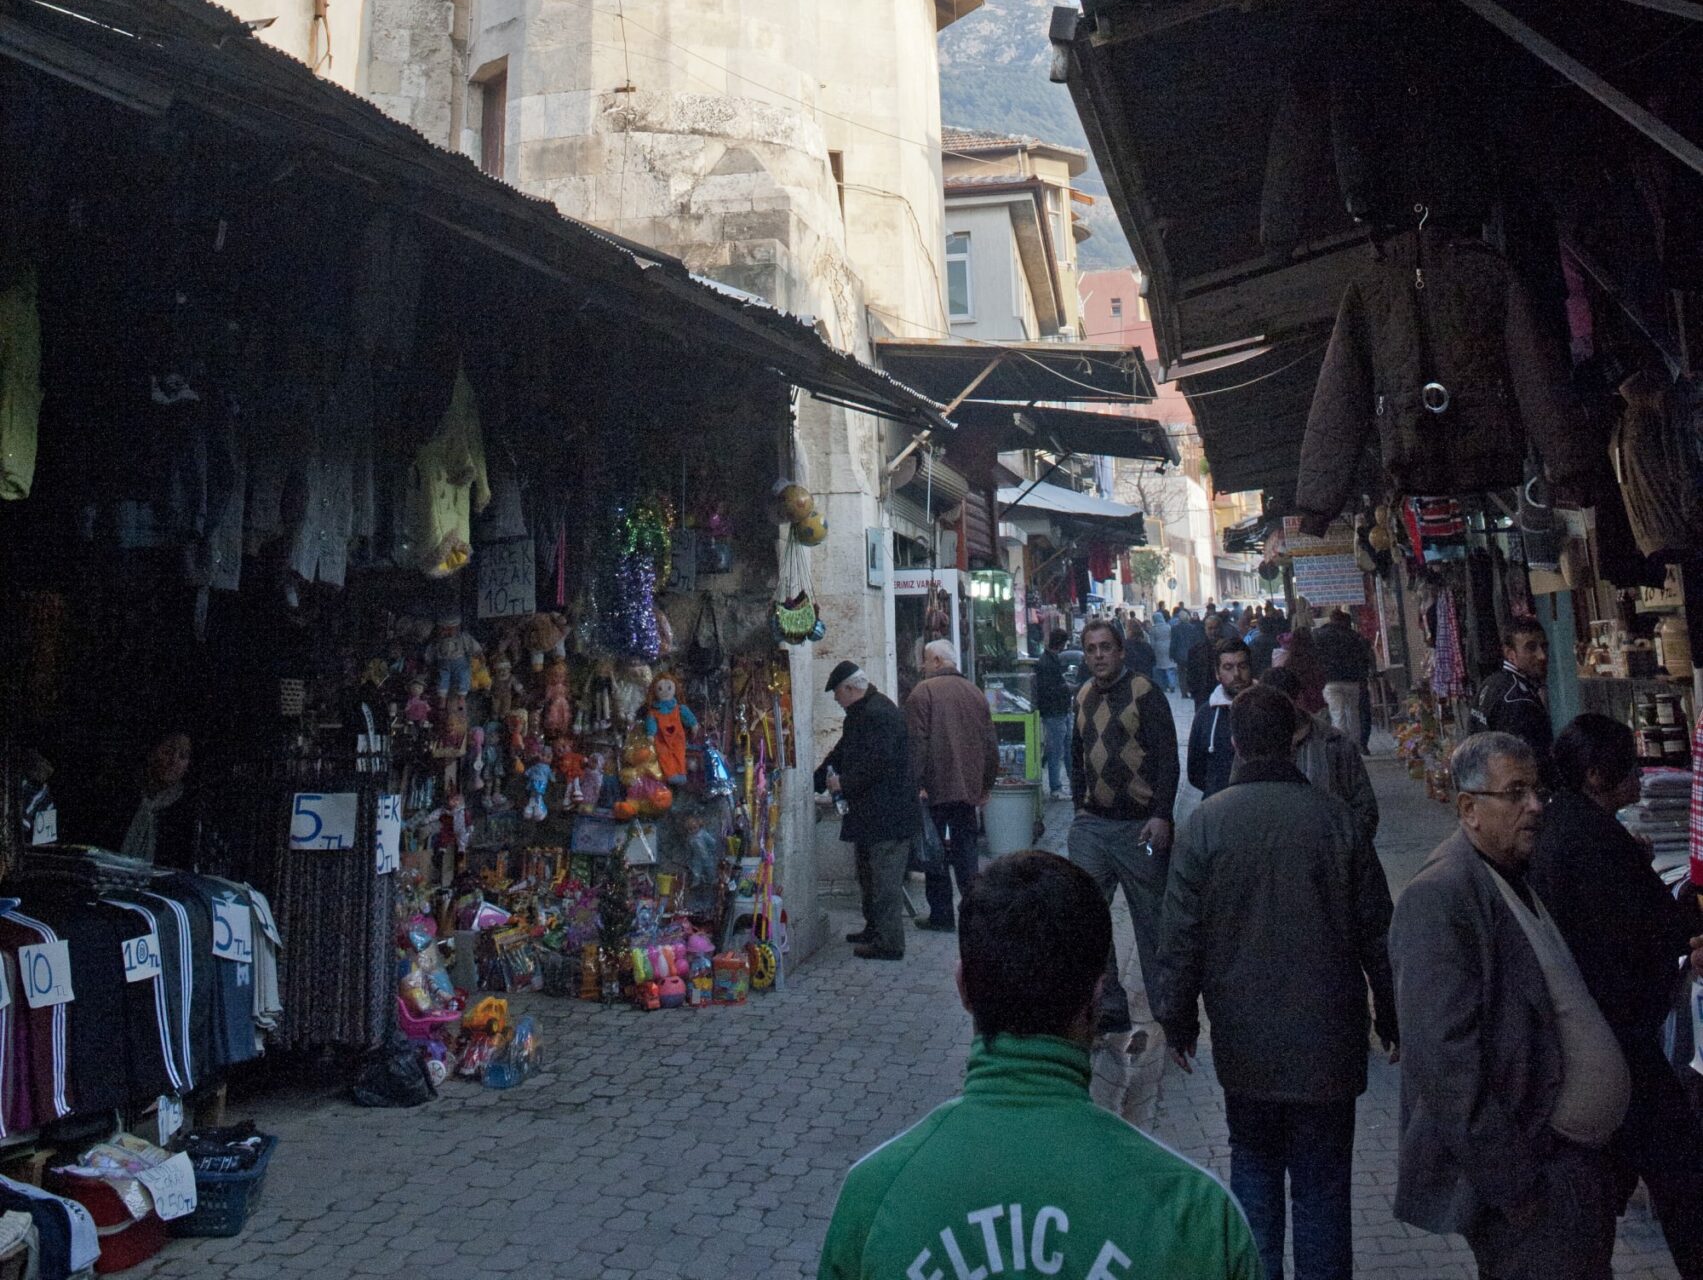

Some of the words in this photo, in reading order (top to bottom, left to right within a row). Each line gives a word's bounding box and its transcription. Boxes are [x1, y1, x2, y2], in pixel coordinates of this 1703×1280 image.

[484, 587, 508, 614] 10
[508, 597, 534, 616] TL
[291, 795, 322, 843] 5
[321, 834, 350, 850] TL
[212, 899, 233, 951] 5
[234, 938, 252, 956] TL
[25, 949, 53, 998] 10
[54, 984, 69, 997] TL
[124, 938, 149, 971] 10
[149, 953, 160, 967] TL
[184, 1196, 195, 1212] TL
